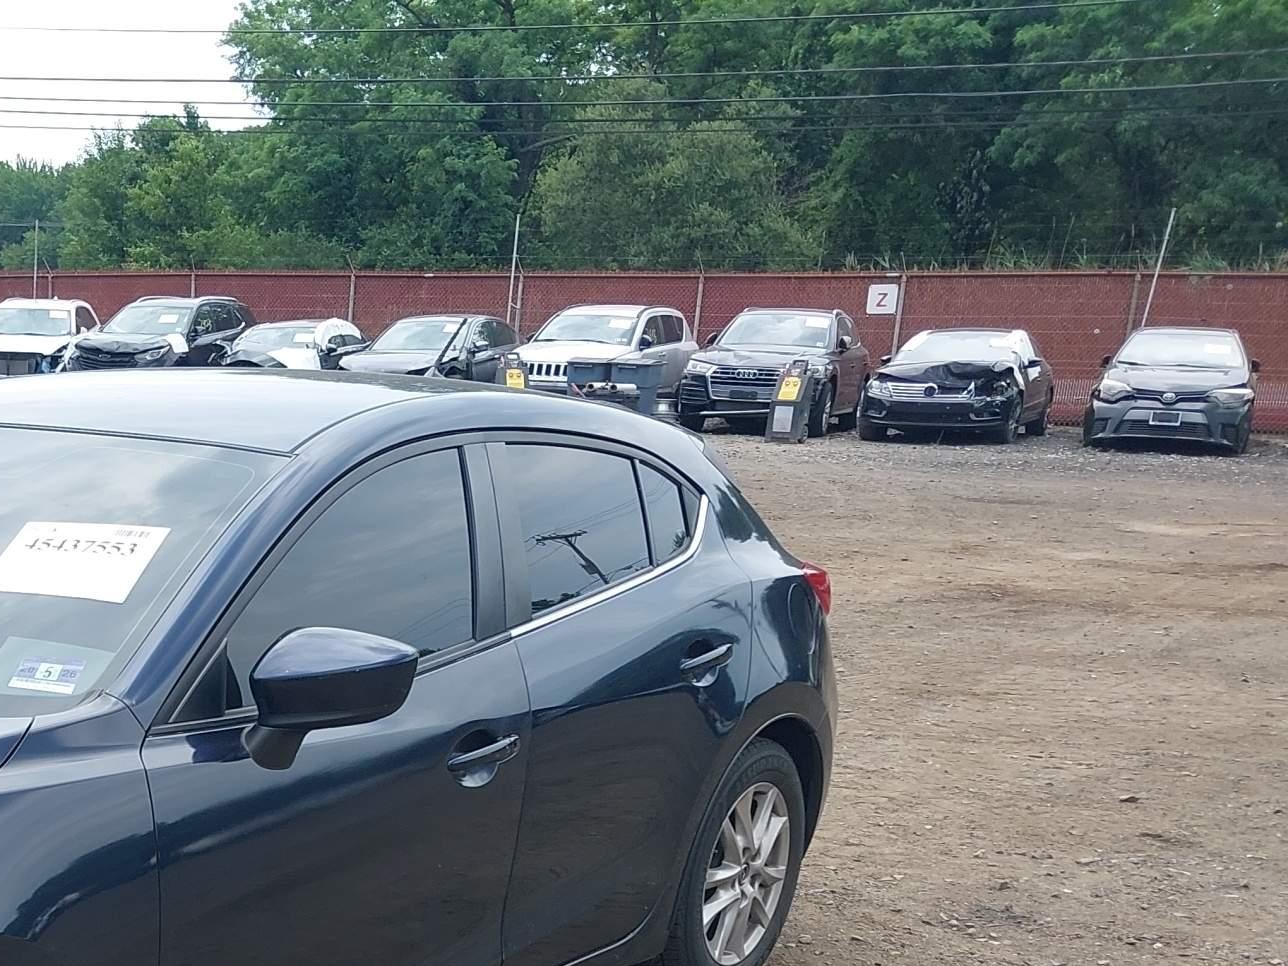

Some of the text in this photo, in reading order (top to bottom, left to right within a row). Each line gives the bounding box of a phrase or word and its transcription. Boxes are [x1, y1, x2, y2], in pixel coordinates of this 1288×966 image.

[876, 293, 889, 307] Z
[25, 538, 138, 555] 45437553
[42, 666, 55, 679] 5
